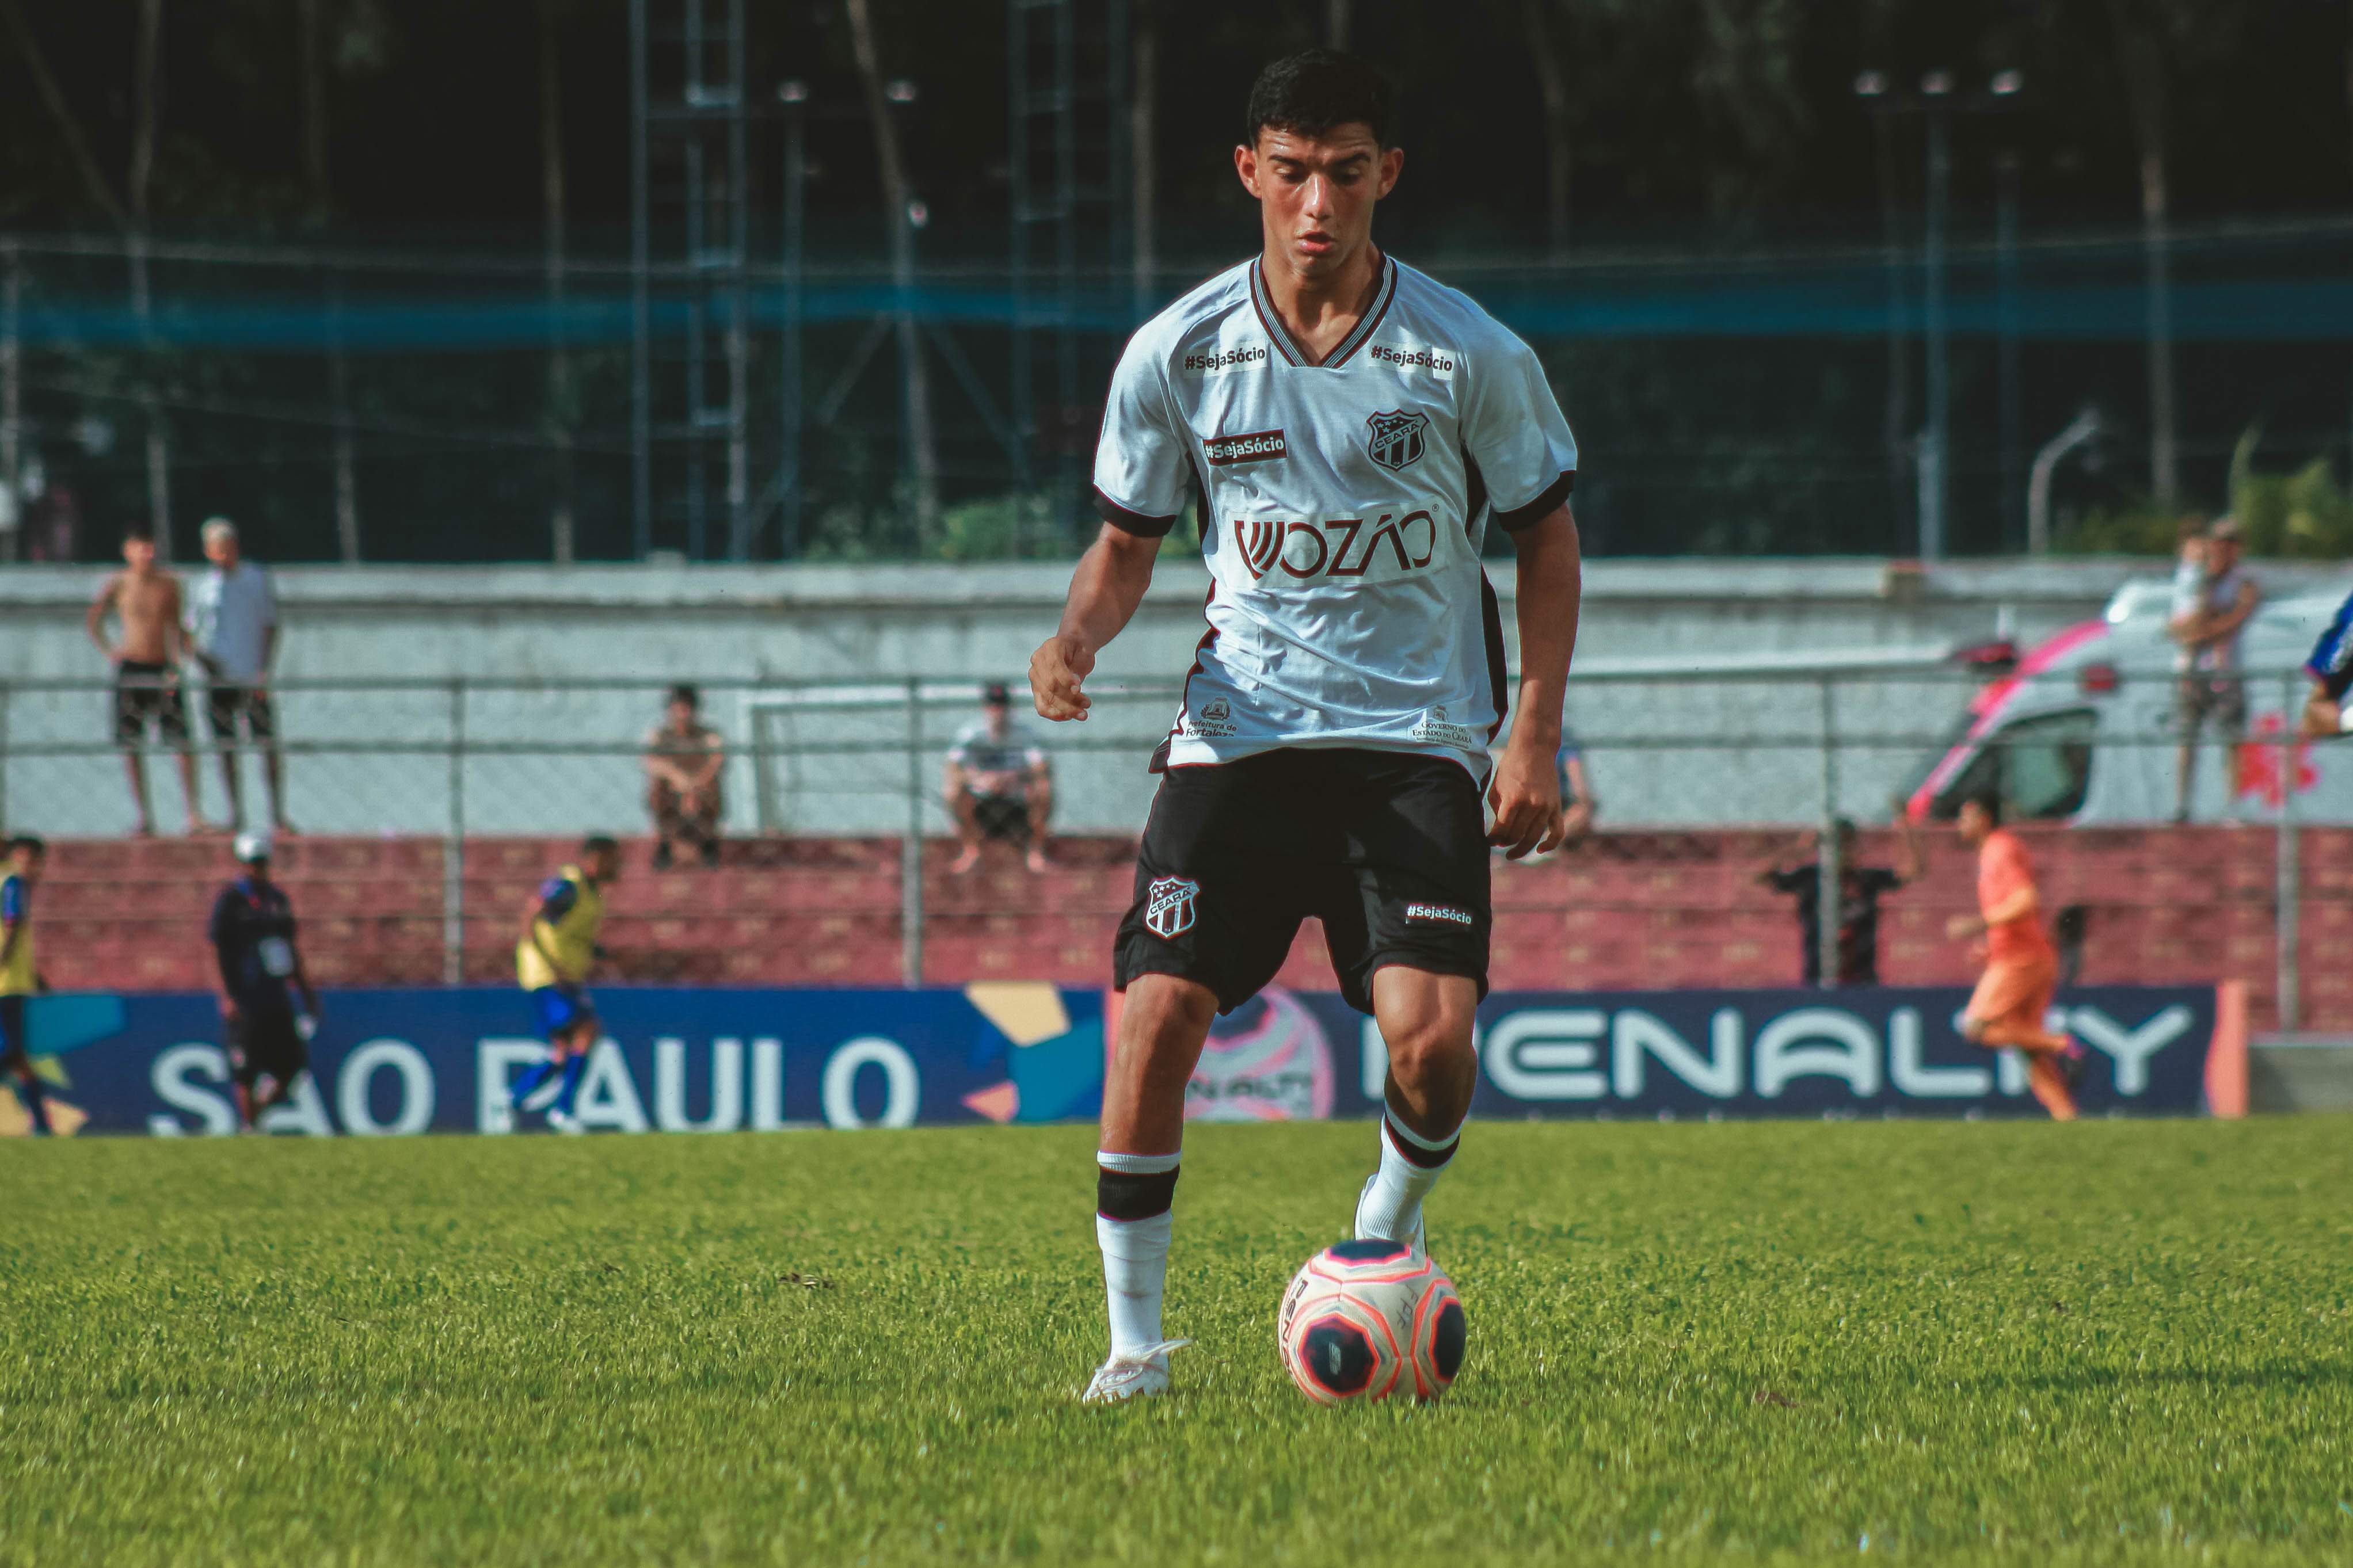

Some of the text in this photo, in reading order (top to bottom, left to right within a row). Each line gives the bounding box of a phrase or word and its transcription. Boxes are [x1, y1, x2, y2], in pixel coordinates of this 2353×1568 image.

[1185, 347, 1265, 370] #SejaSócio
[1370, 345, 1453, 371] #SejaSócio
[1205, 437, 1284, 459] #SejaSócio
[1188, 720, 1224, 729] Prefeitura
[1421, 721, 1457, 731] GOVERNO
[1150, 887, 1193, 914] CEARÁ
[1407, 906, 1472, 924] #SejaSócio
[477, 1035, 920, 1134] PAULO
